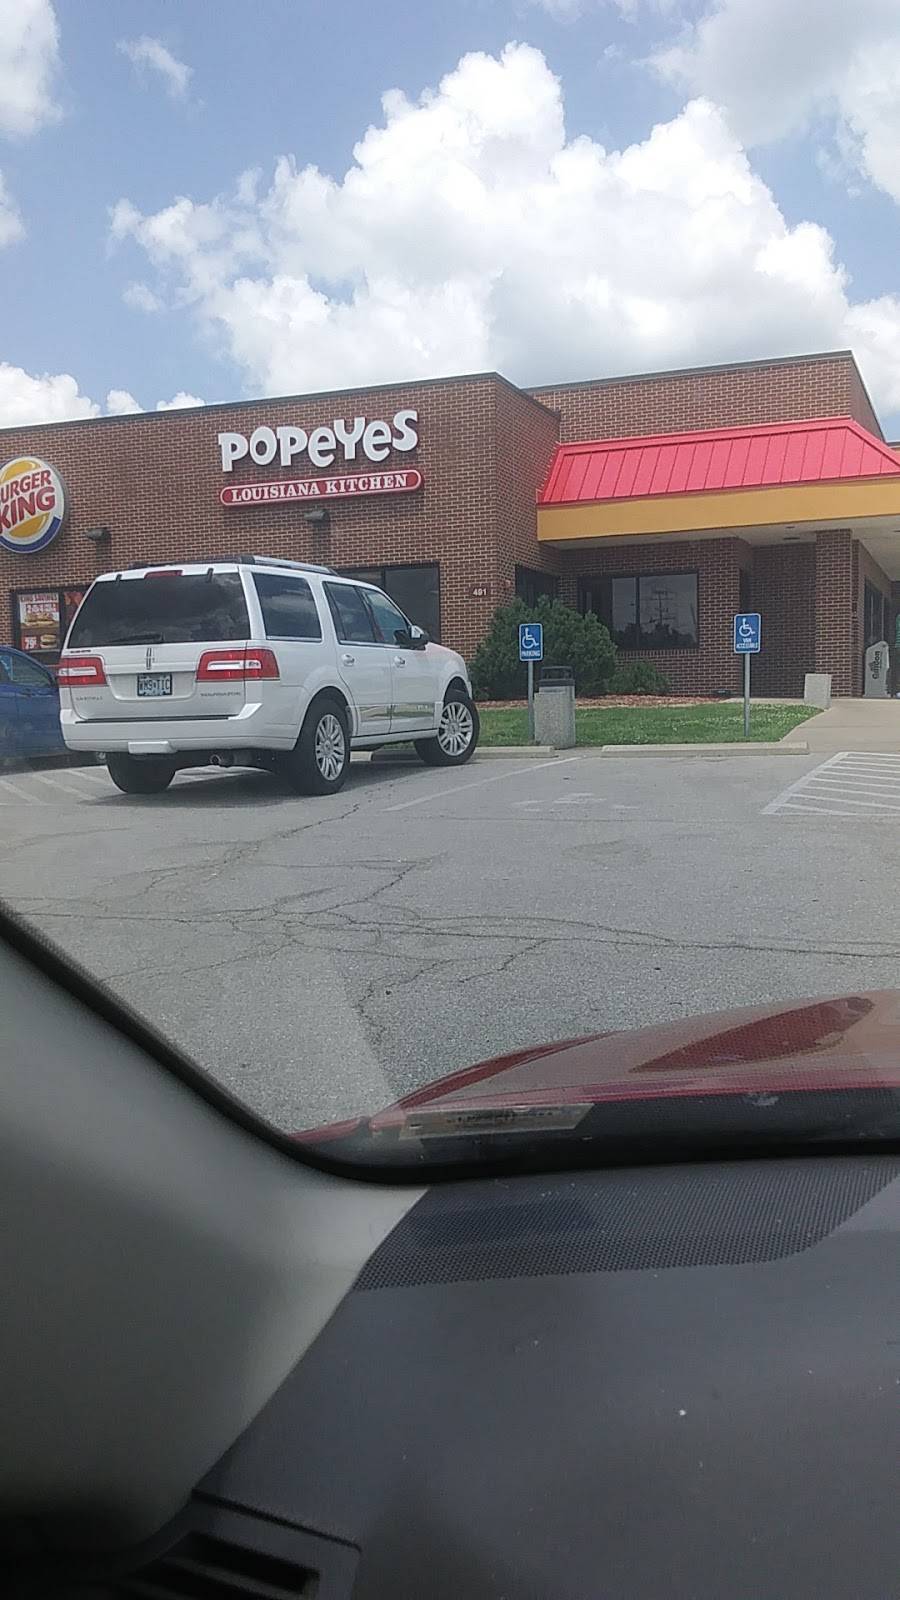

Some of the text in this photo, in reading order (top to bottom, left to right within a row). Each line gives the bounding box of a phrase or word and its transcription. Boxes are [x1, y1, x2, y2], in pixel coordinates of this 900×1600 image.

[0, 470, 52, 503] URGER
[231, 474, 409, 502] LOUISIANA KITCHEN
[0, 486, 56, 534] KING
[473, 588, 487, 596] 491
